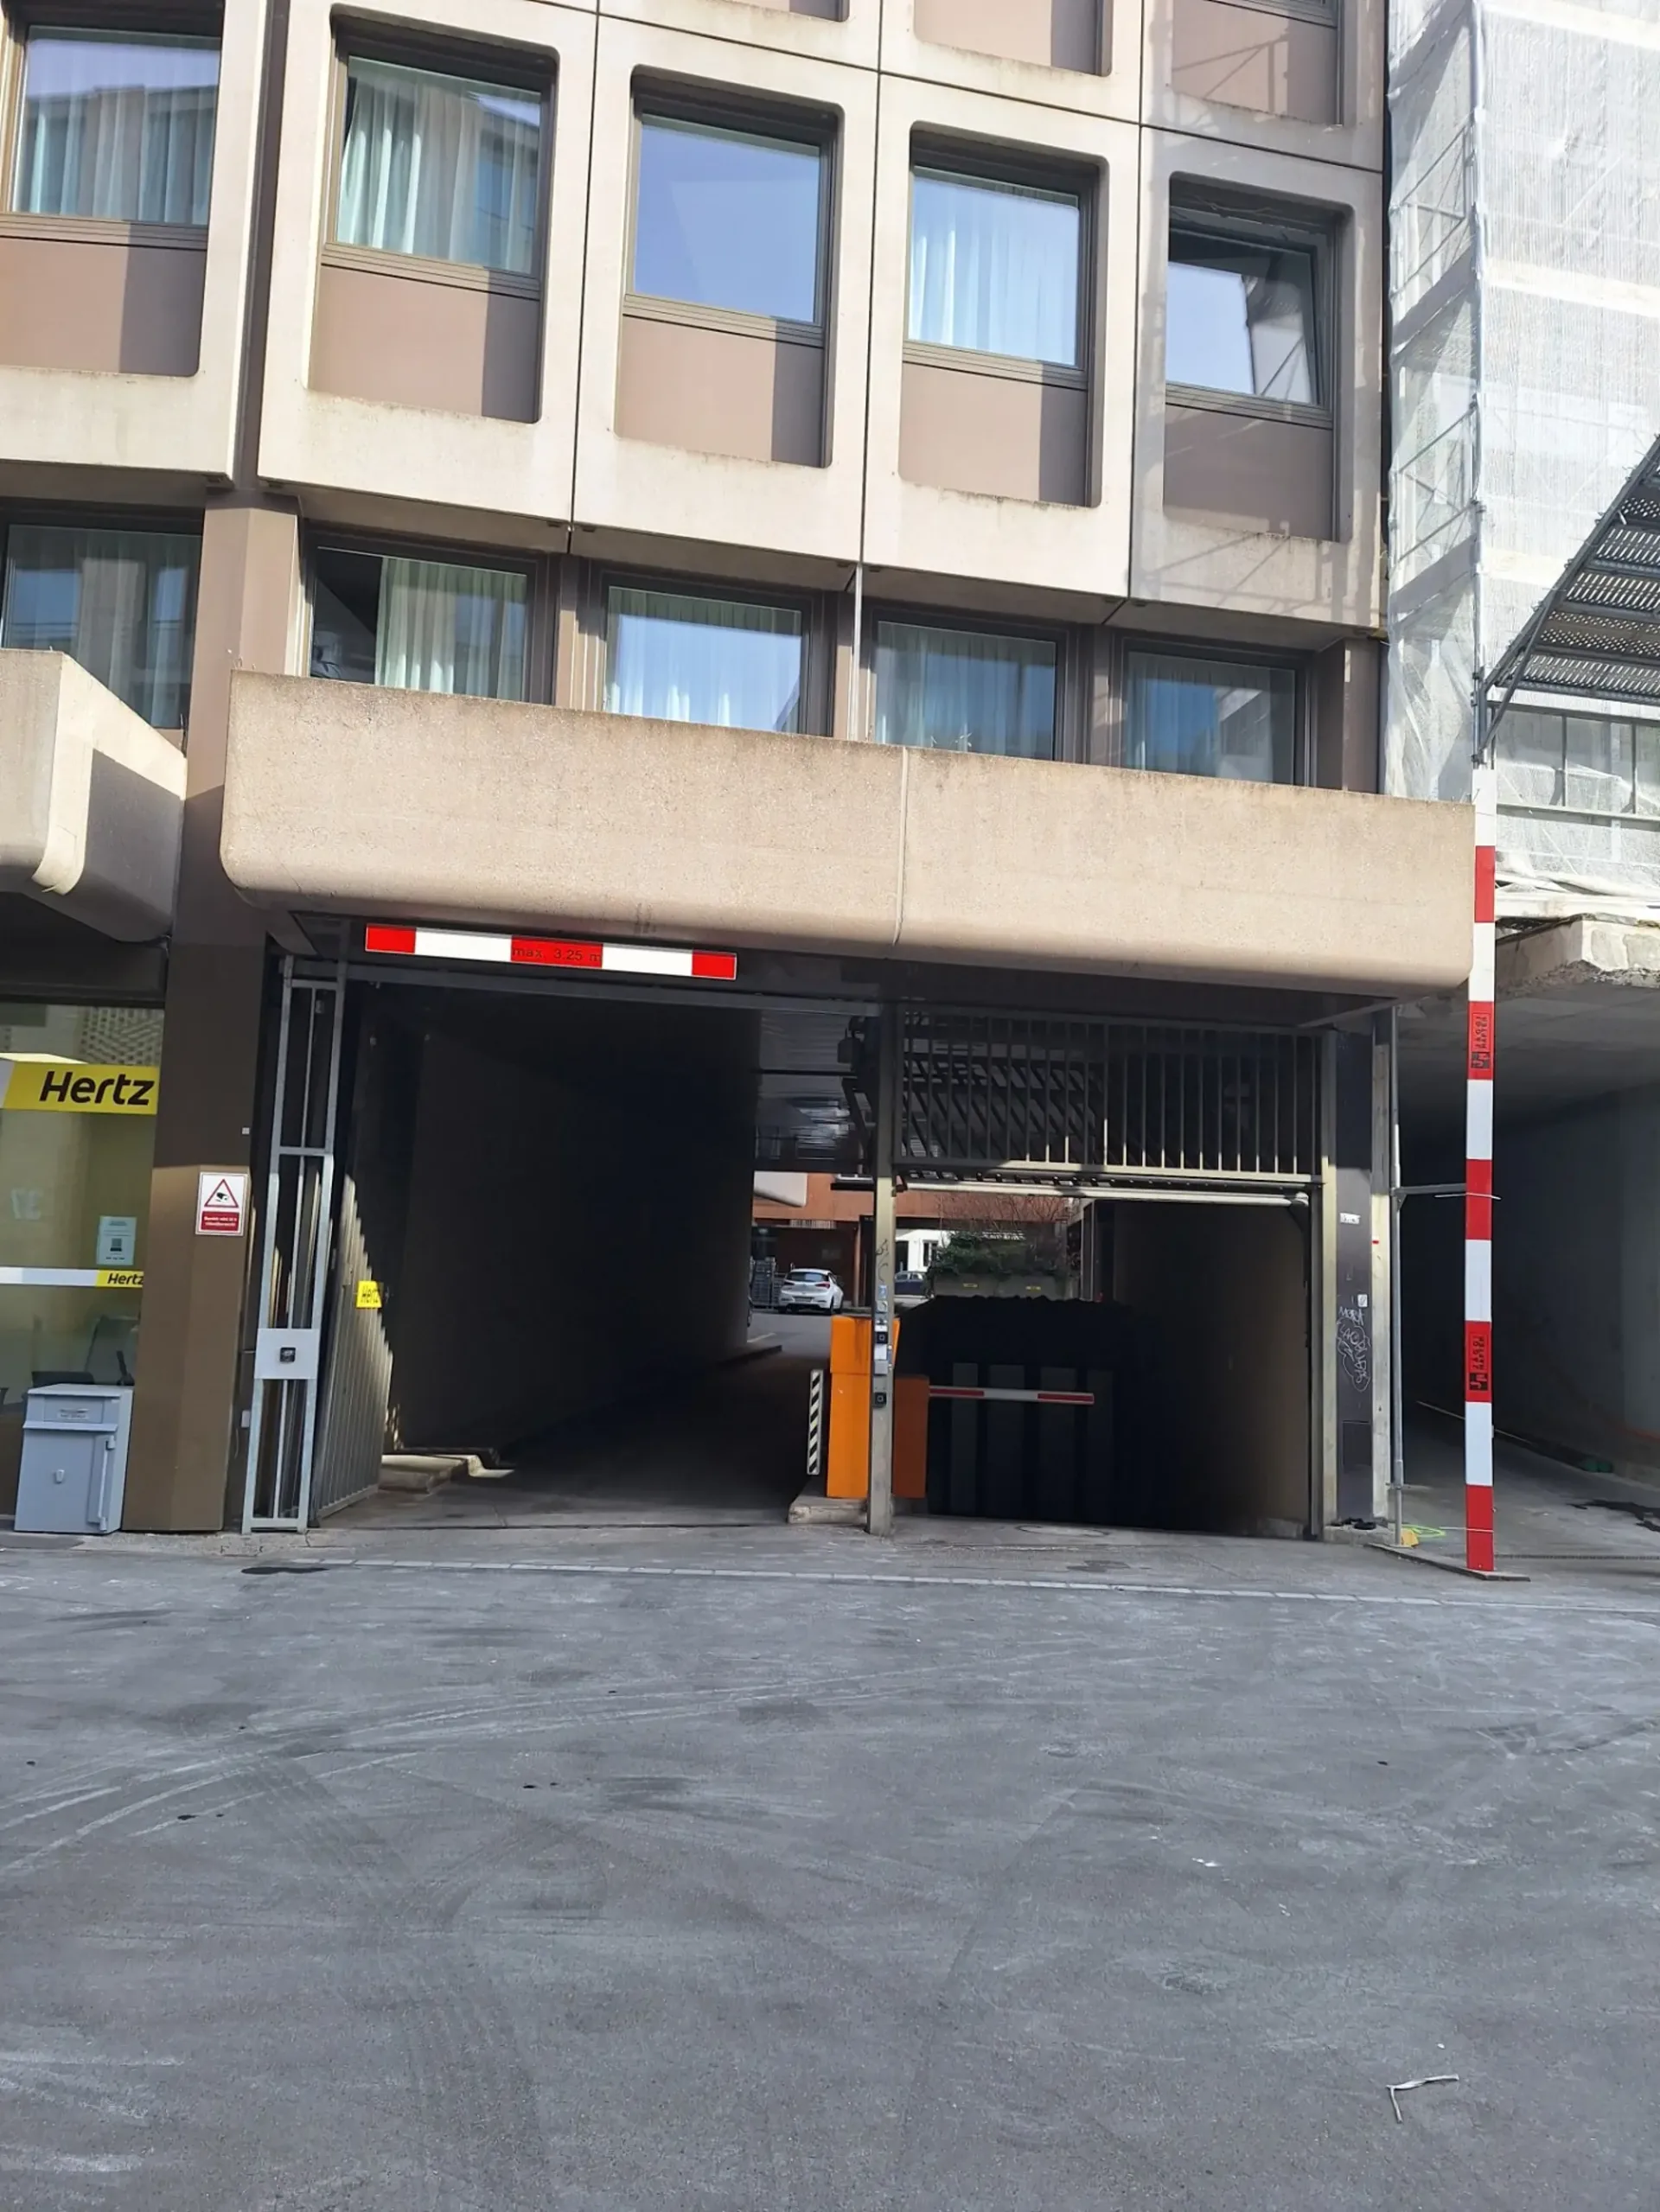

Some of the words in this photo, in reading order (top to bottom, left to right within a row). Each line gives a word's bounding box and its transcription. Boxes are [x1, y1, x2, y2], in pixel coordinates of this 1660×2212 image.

[553, 947, 583, 961] 3.25
[39, 1071, 156, 1106] Hertz
[107, 1272, 144, 1285] Hertz
